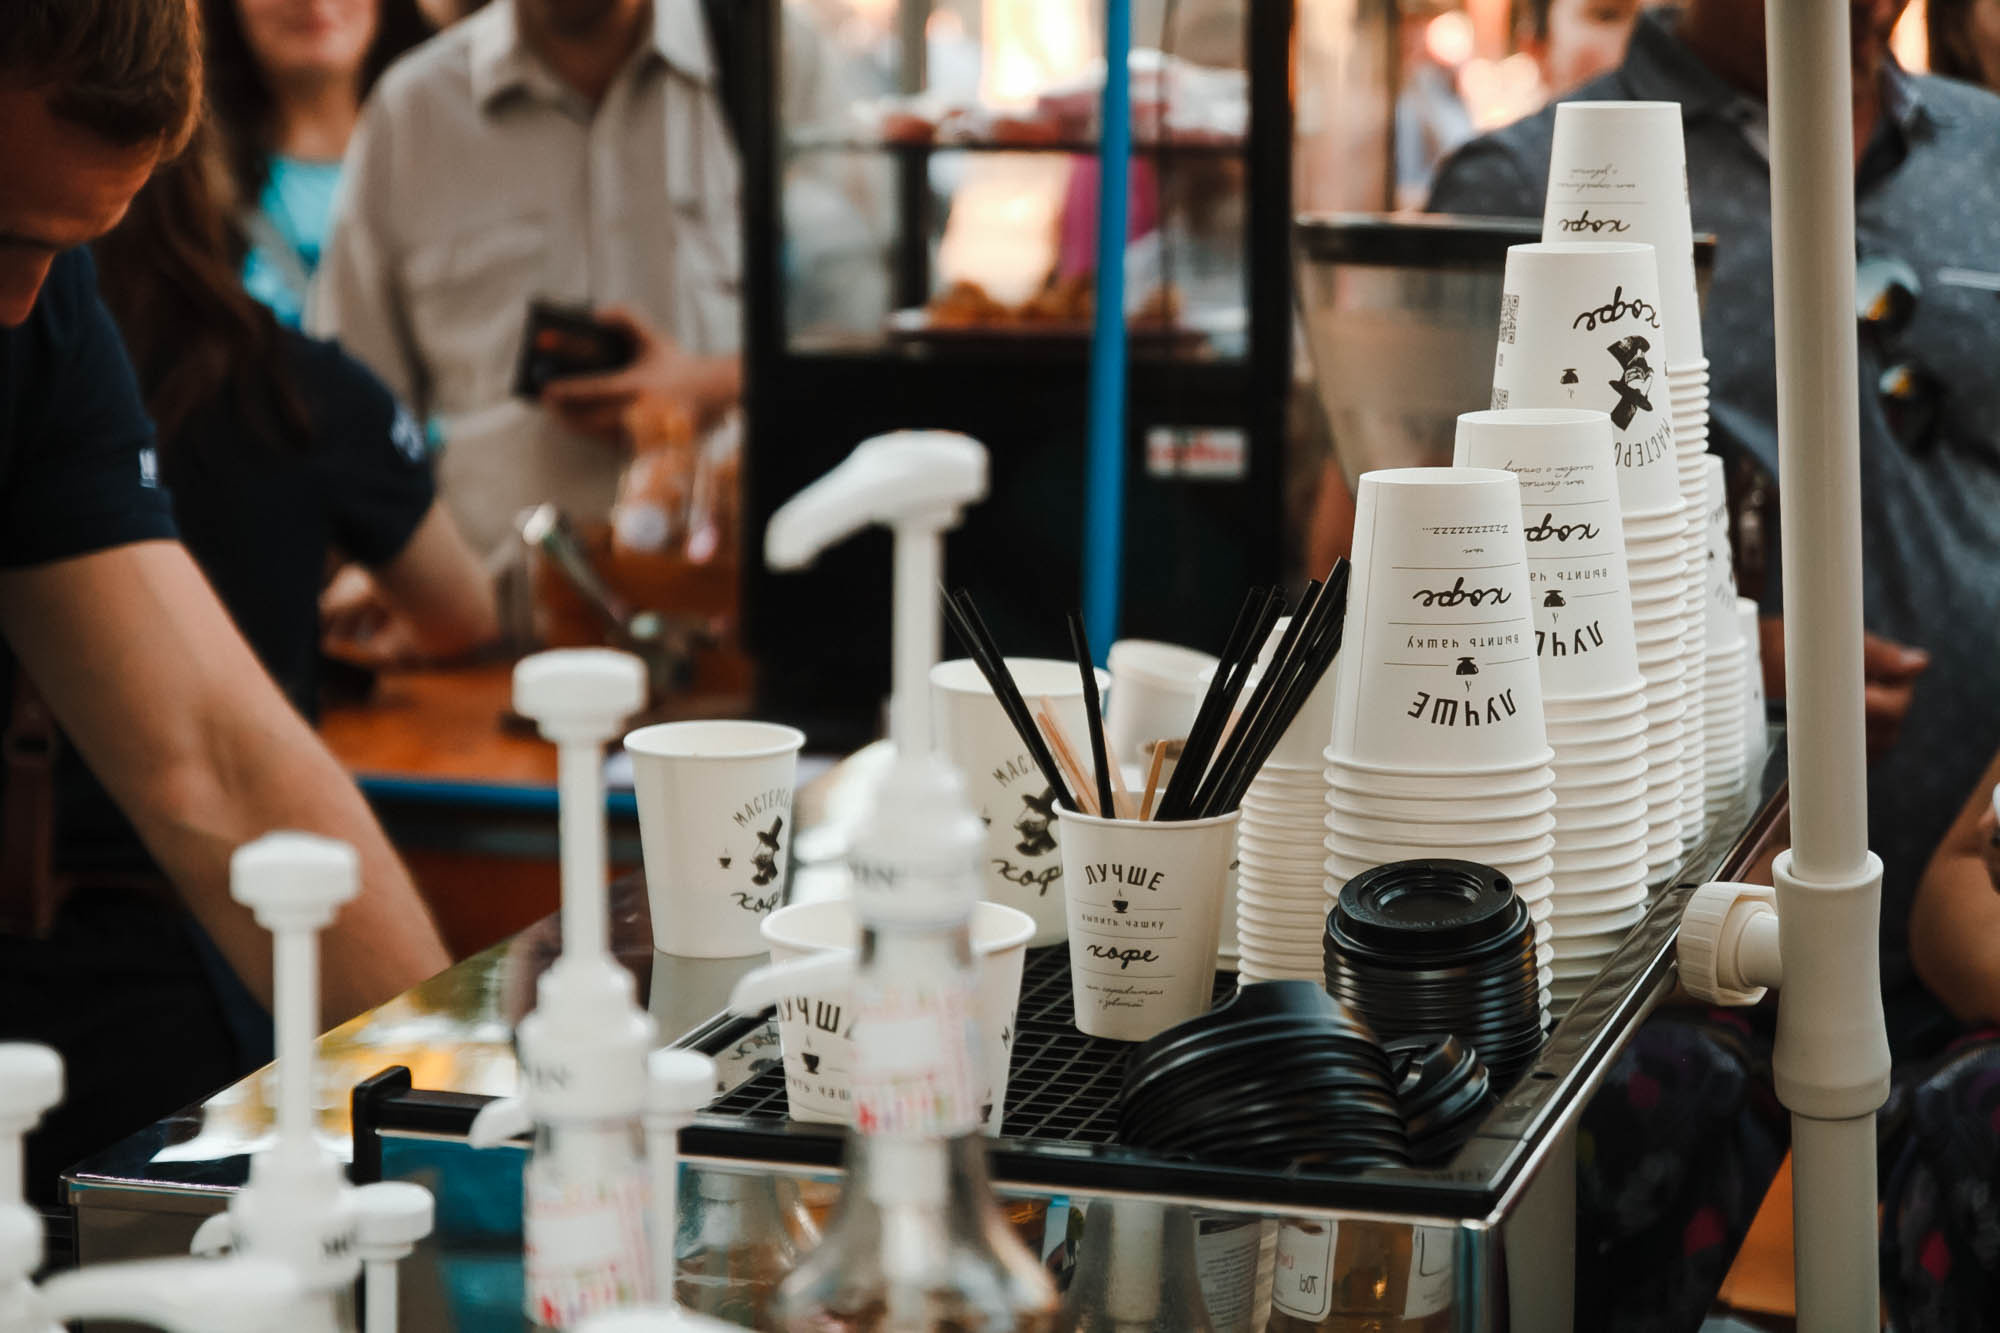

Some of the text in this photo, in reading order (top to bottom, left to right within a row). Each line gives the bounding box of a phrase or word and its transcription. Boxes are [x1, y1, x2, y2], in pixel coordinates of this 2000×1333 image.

[1573, 286, 1660, 331] кофе
[1557, 567, 1608, 581] выпить
[1412, 576, 1511, 607] кофе
[1407, 633, 1520, 649] выпить чашку
[1407, 688, 1516, 727] ЛУЧШЕ
[1085, 863, 1165, 891] ЛУЧШЕ
[1125, 919, 1164, 931] чашку
[1086, 944, 1159, 970] кофе
